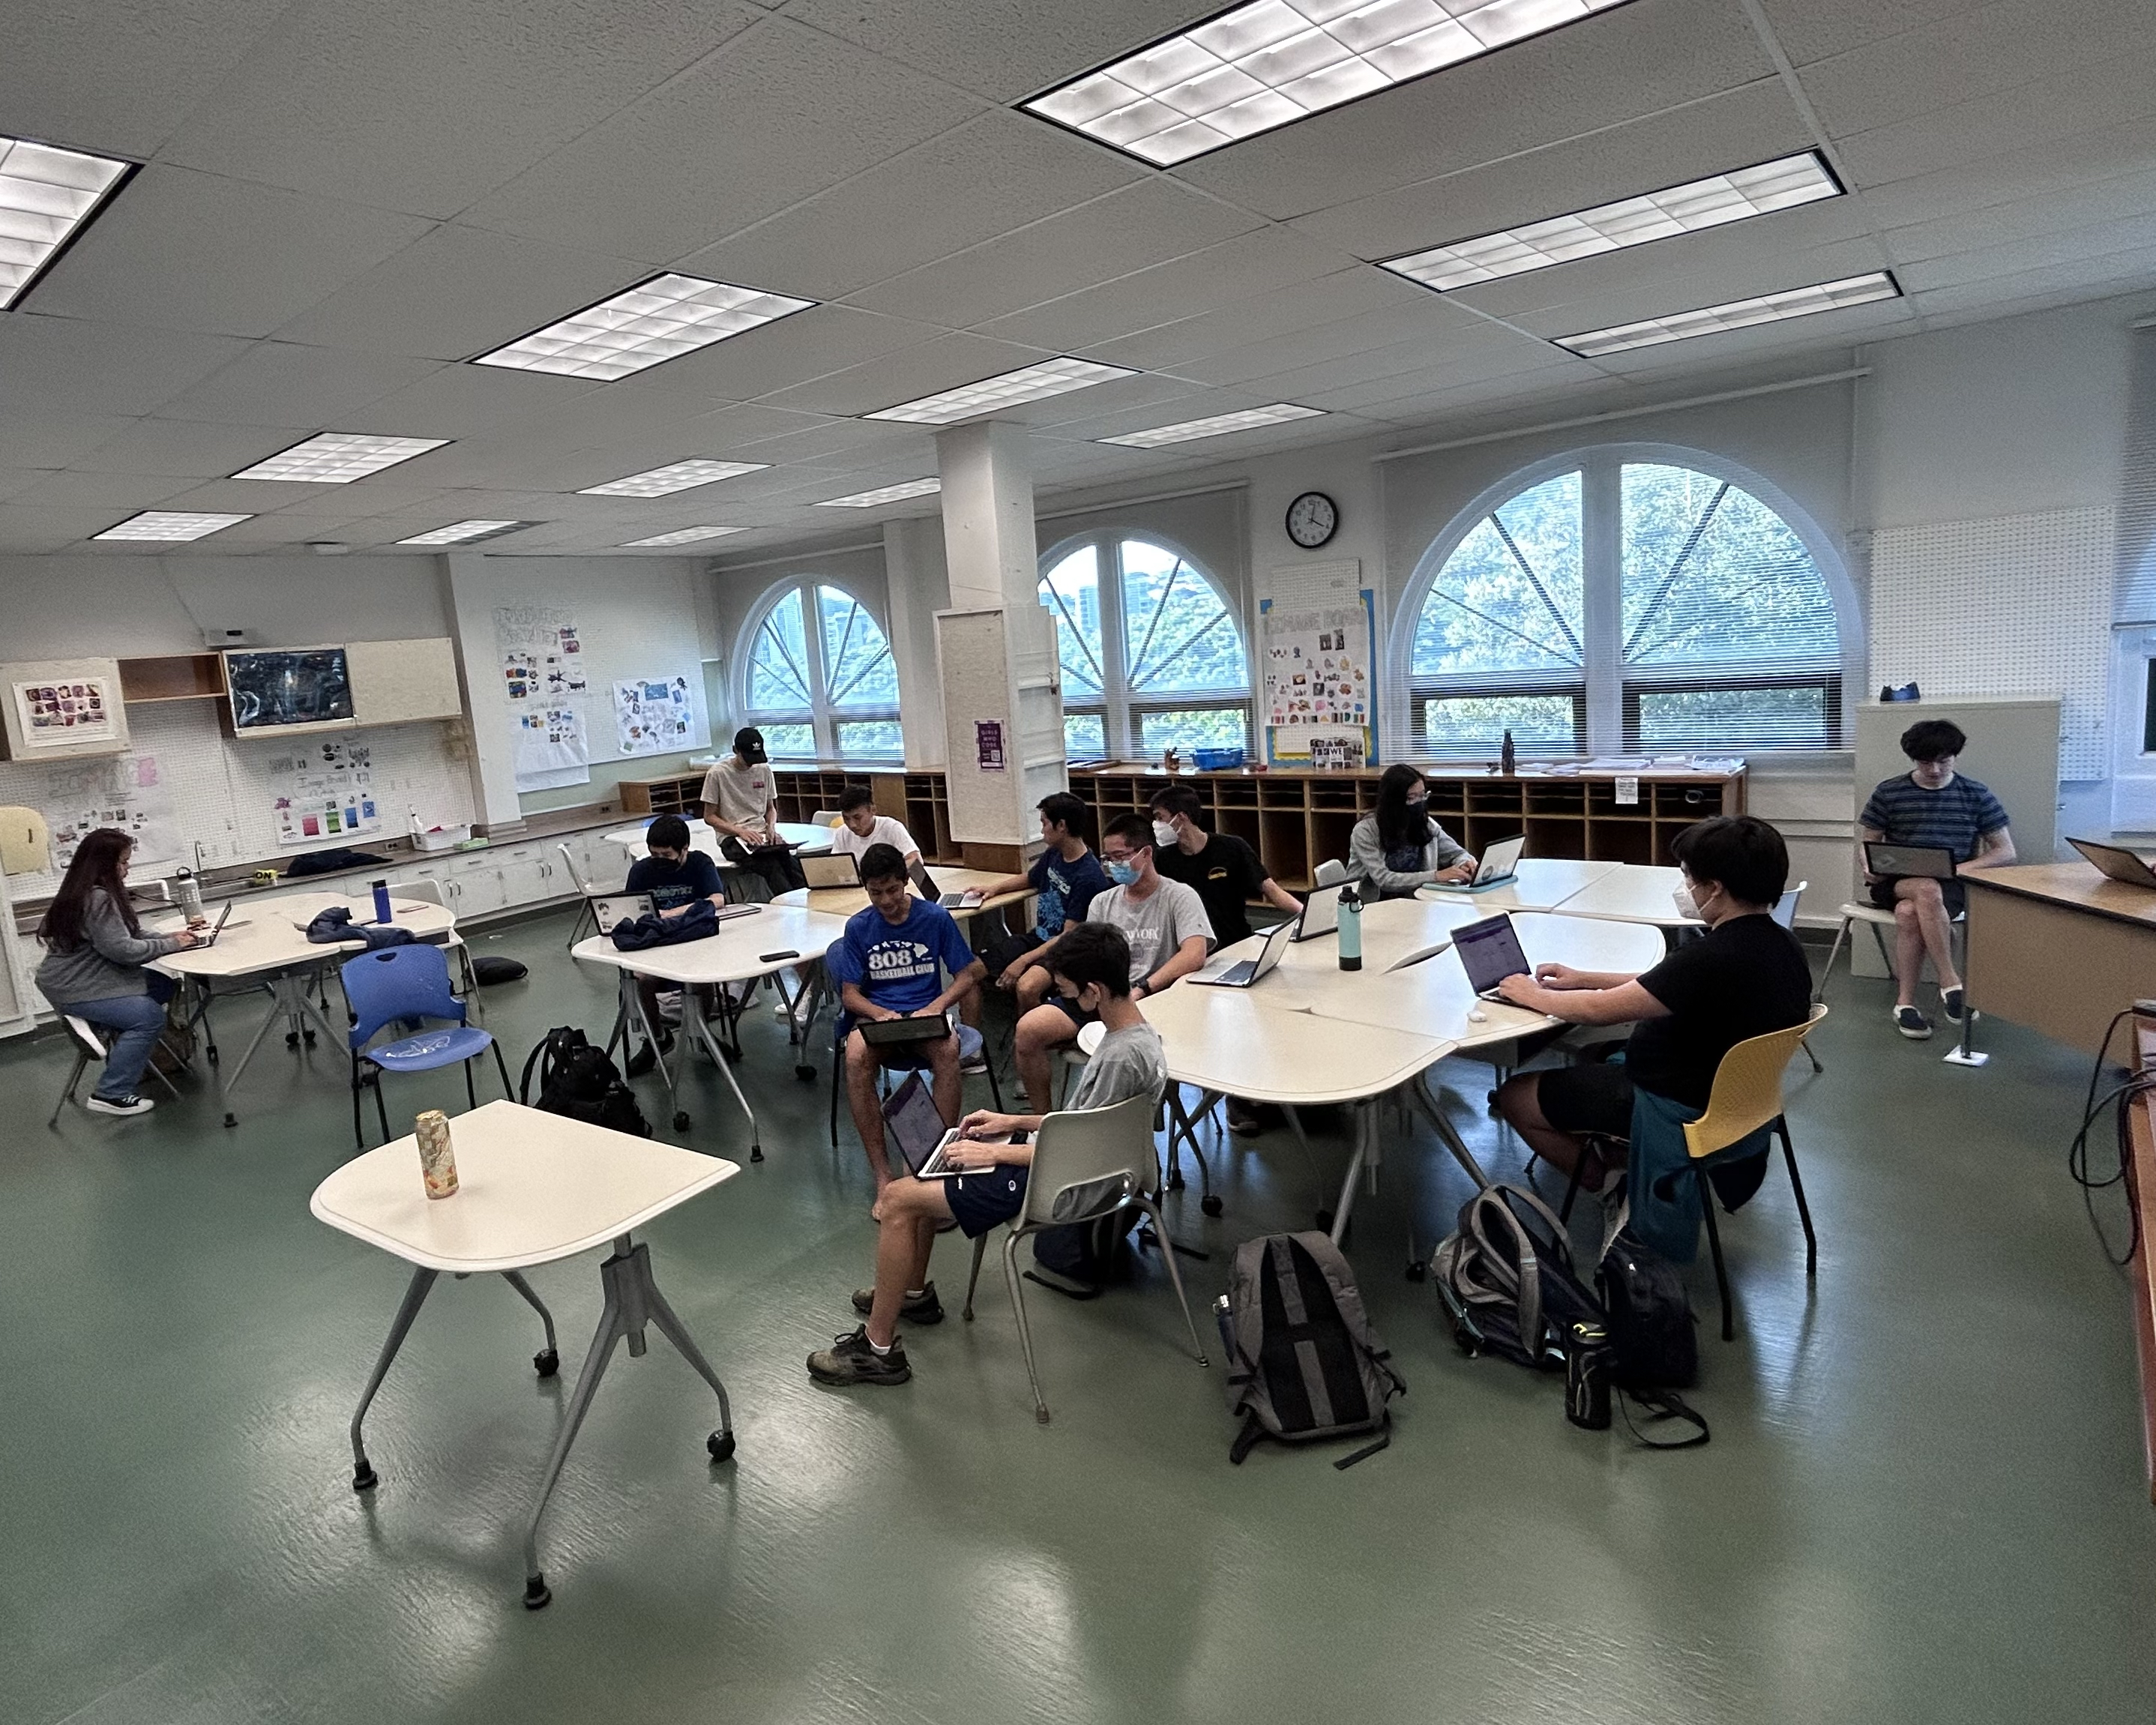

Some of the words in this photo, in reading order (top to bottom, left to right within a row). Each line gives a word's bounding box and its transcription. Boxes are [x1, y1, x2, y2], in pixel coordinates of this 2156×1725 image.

[869, 949, 912, 970] 808
[870, 965, 916, 981] BASKETBALL
[915, 963, 935, 975] CLUB
